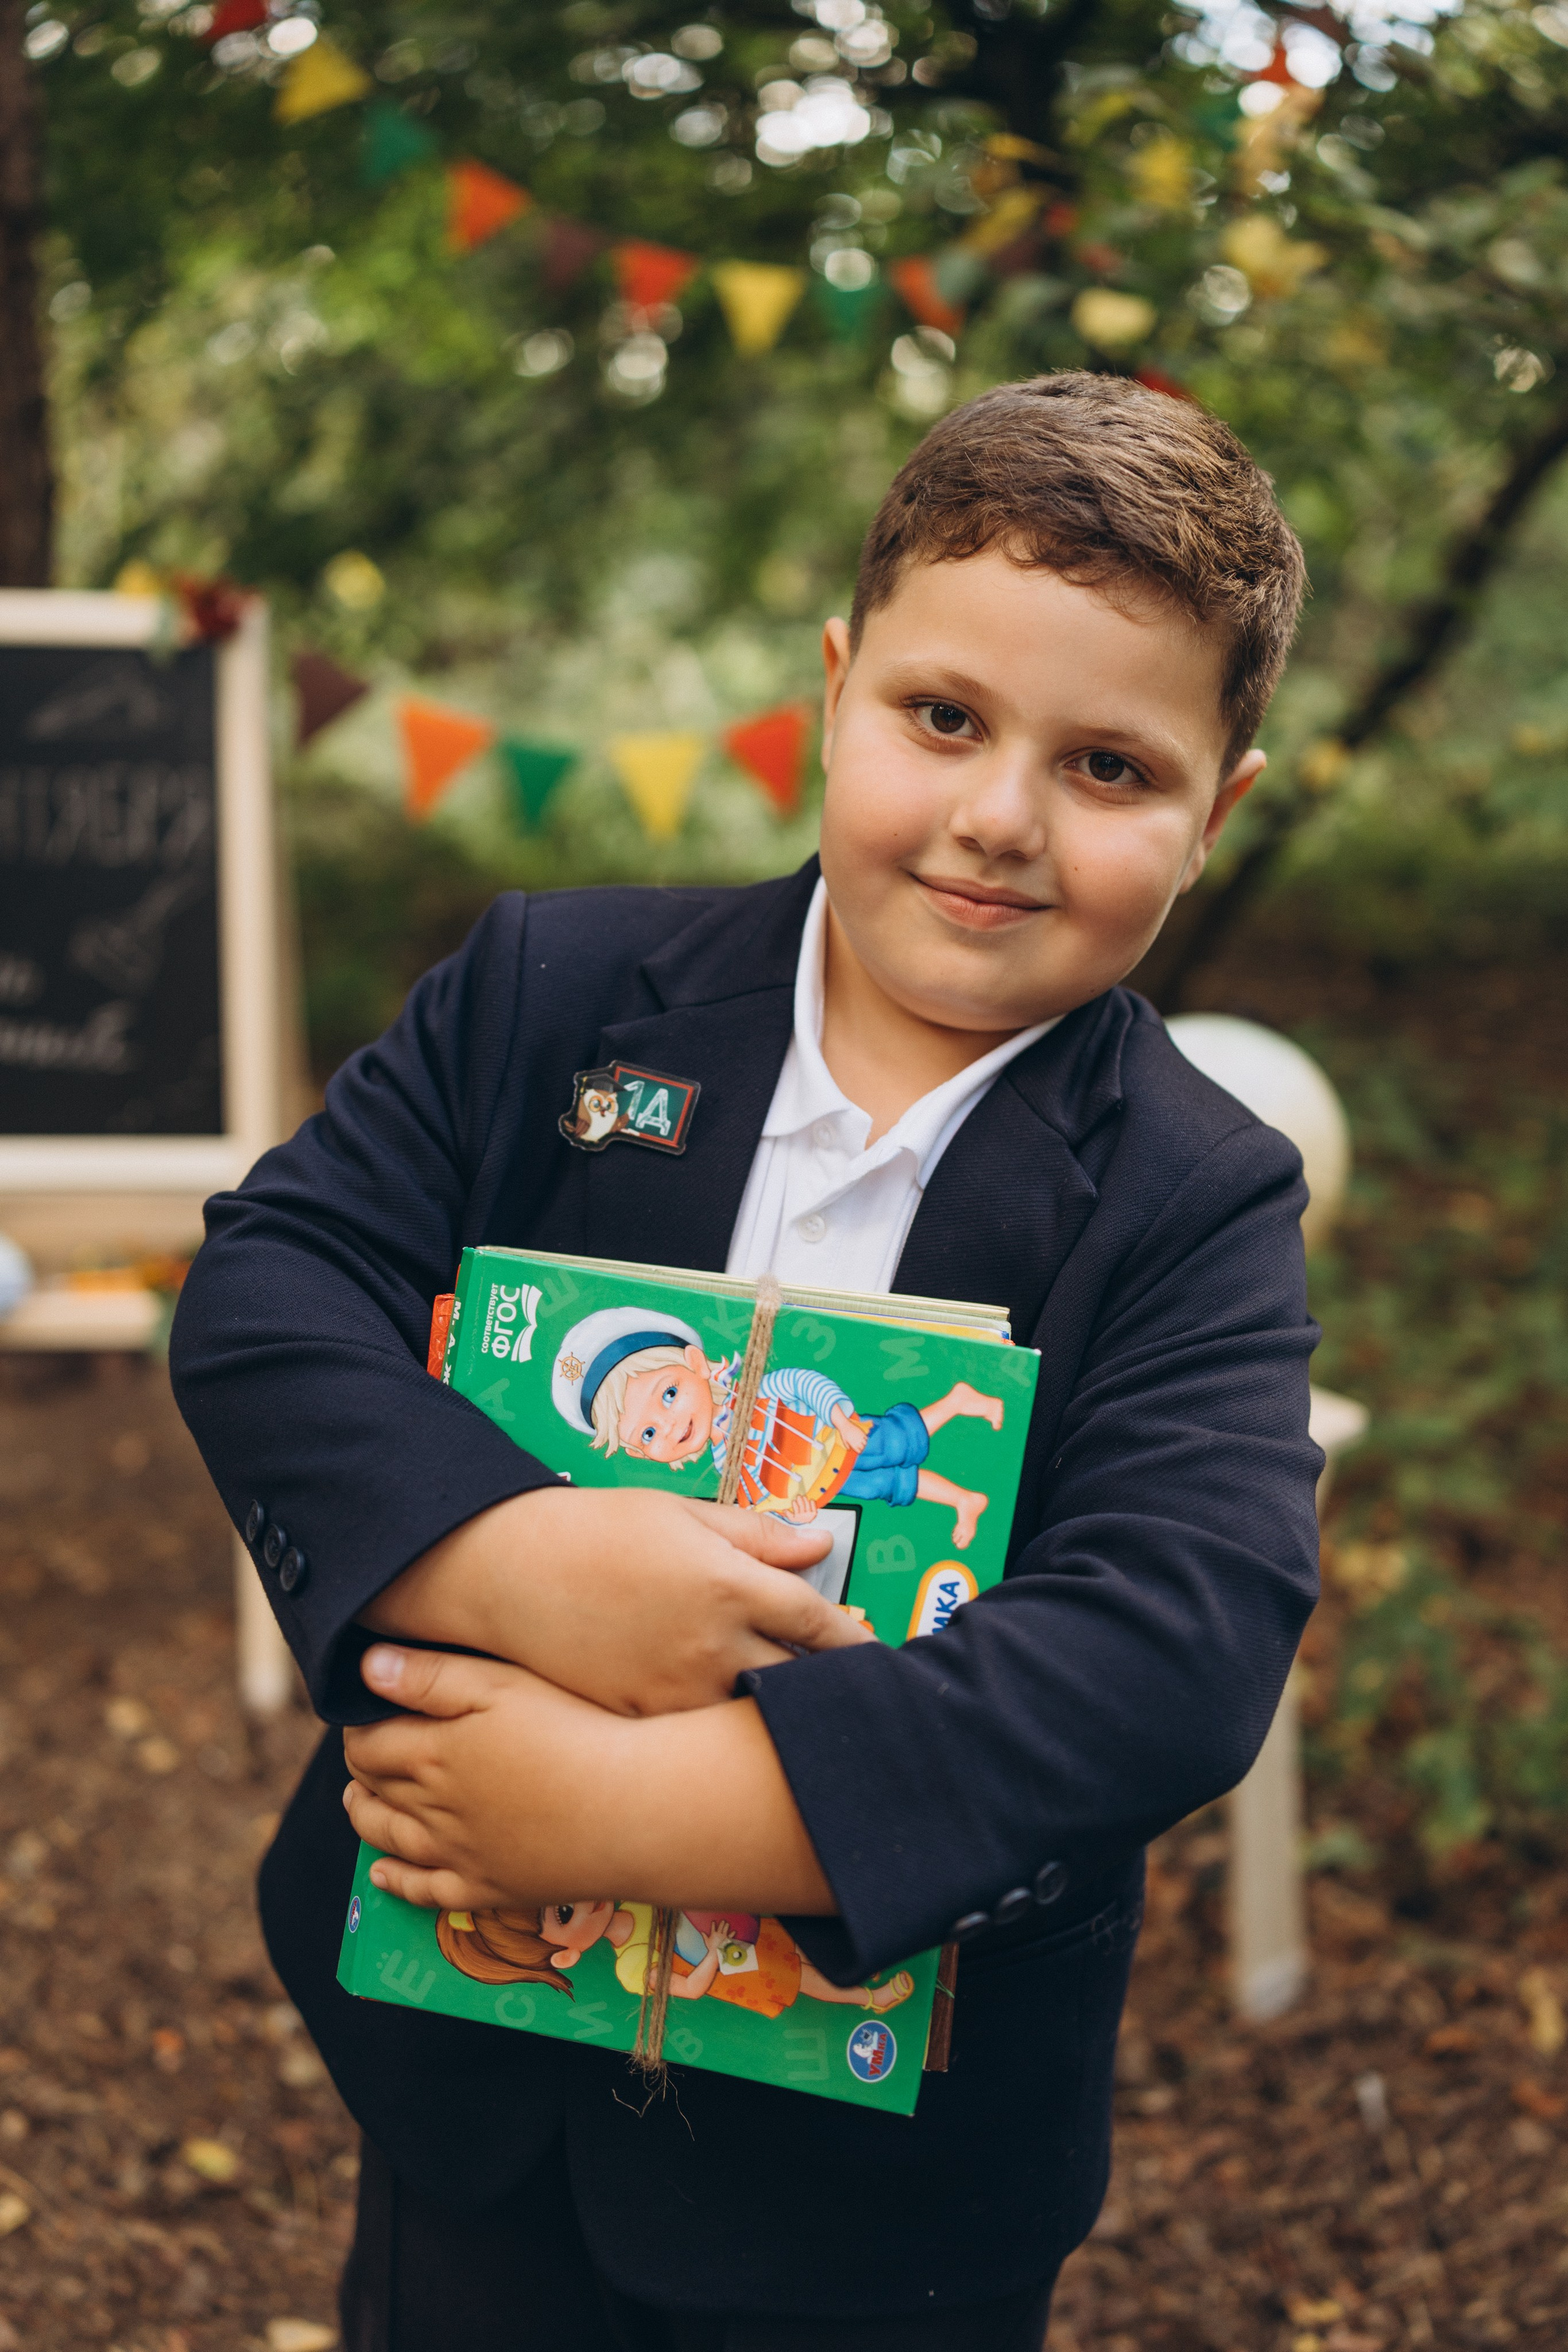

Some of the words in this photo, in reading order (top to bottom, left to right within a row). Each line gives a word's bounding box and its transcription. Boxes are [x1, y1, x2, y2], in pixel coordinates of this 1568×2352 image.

[624, 1080, 671, 1137] 1Д
[481, 1283, 499, 1354] соответствует
[491, 1285, 521, 1359] ФГОС
